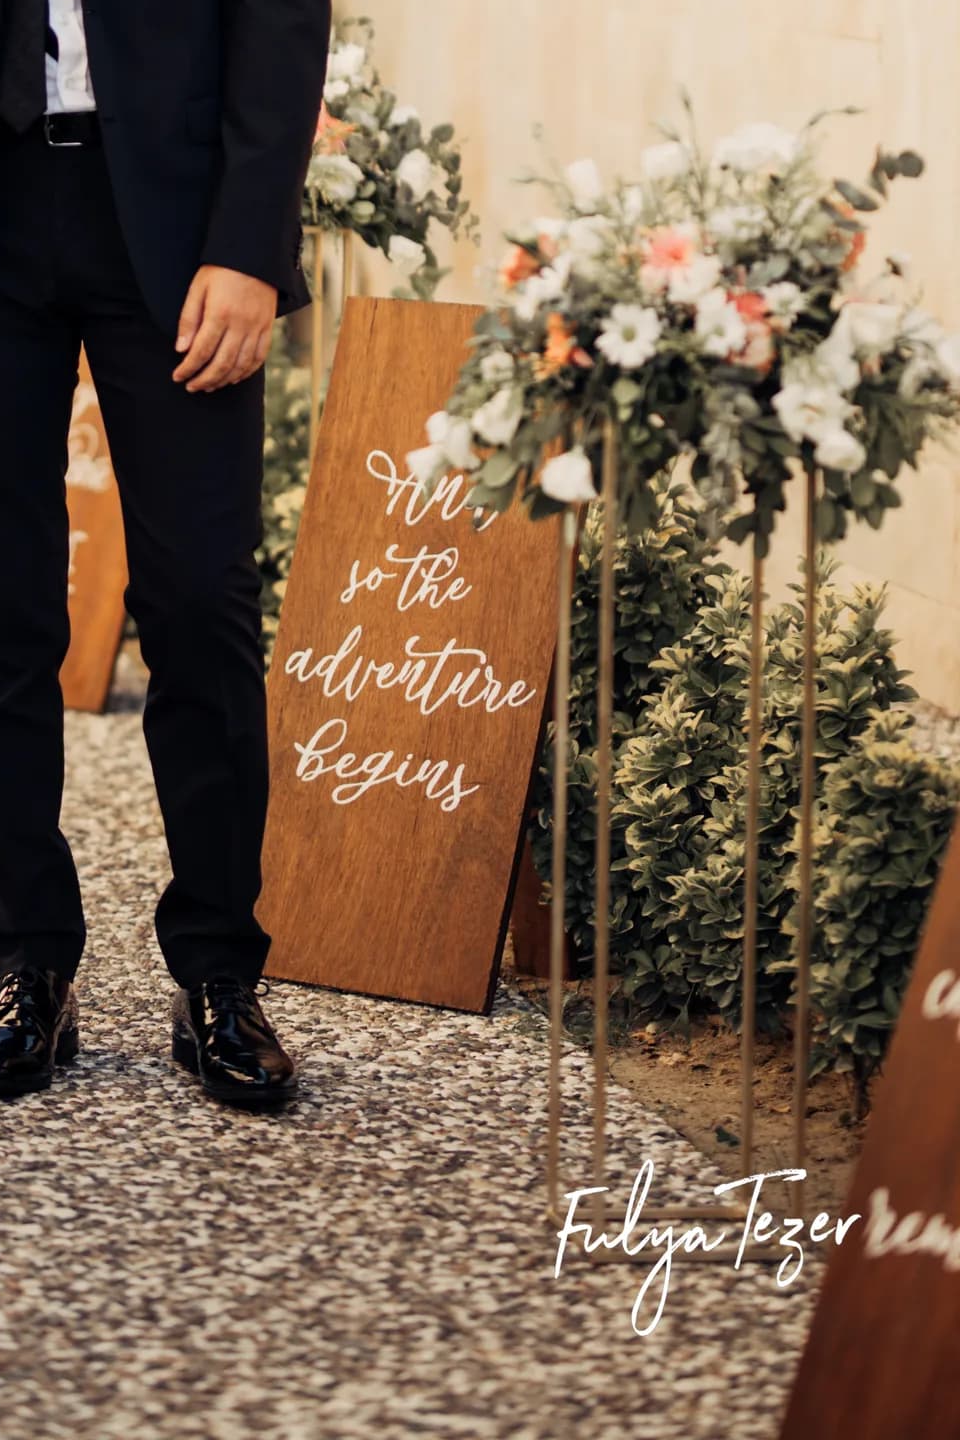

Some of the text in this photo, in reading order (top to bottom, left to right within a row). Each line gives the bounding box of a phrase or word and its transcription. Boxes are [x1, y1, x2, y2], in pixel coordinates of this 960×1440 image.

[366, 448, 499, 532] An
[340, 543, 473, 612] so the
[285, 624, 537, 715] adventure
[294, 718, 480, 812] begins
